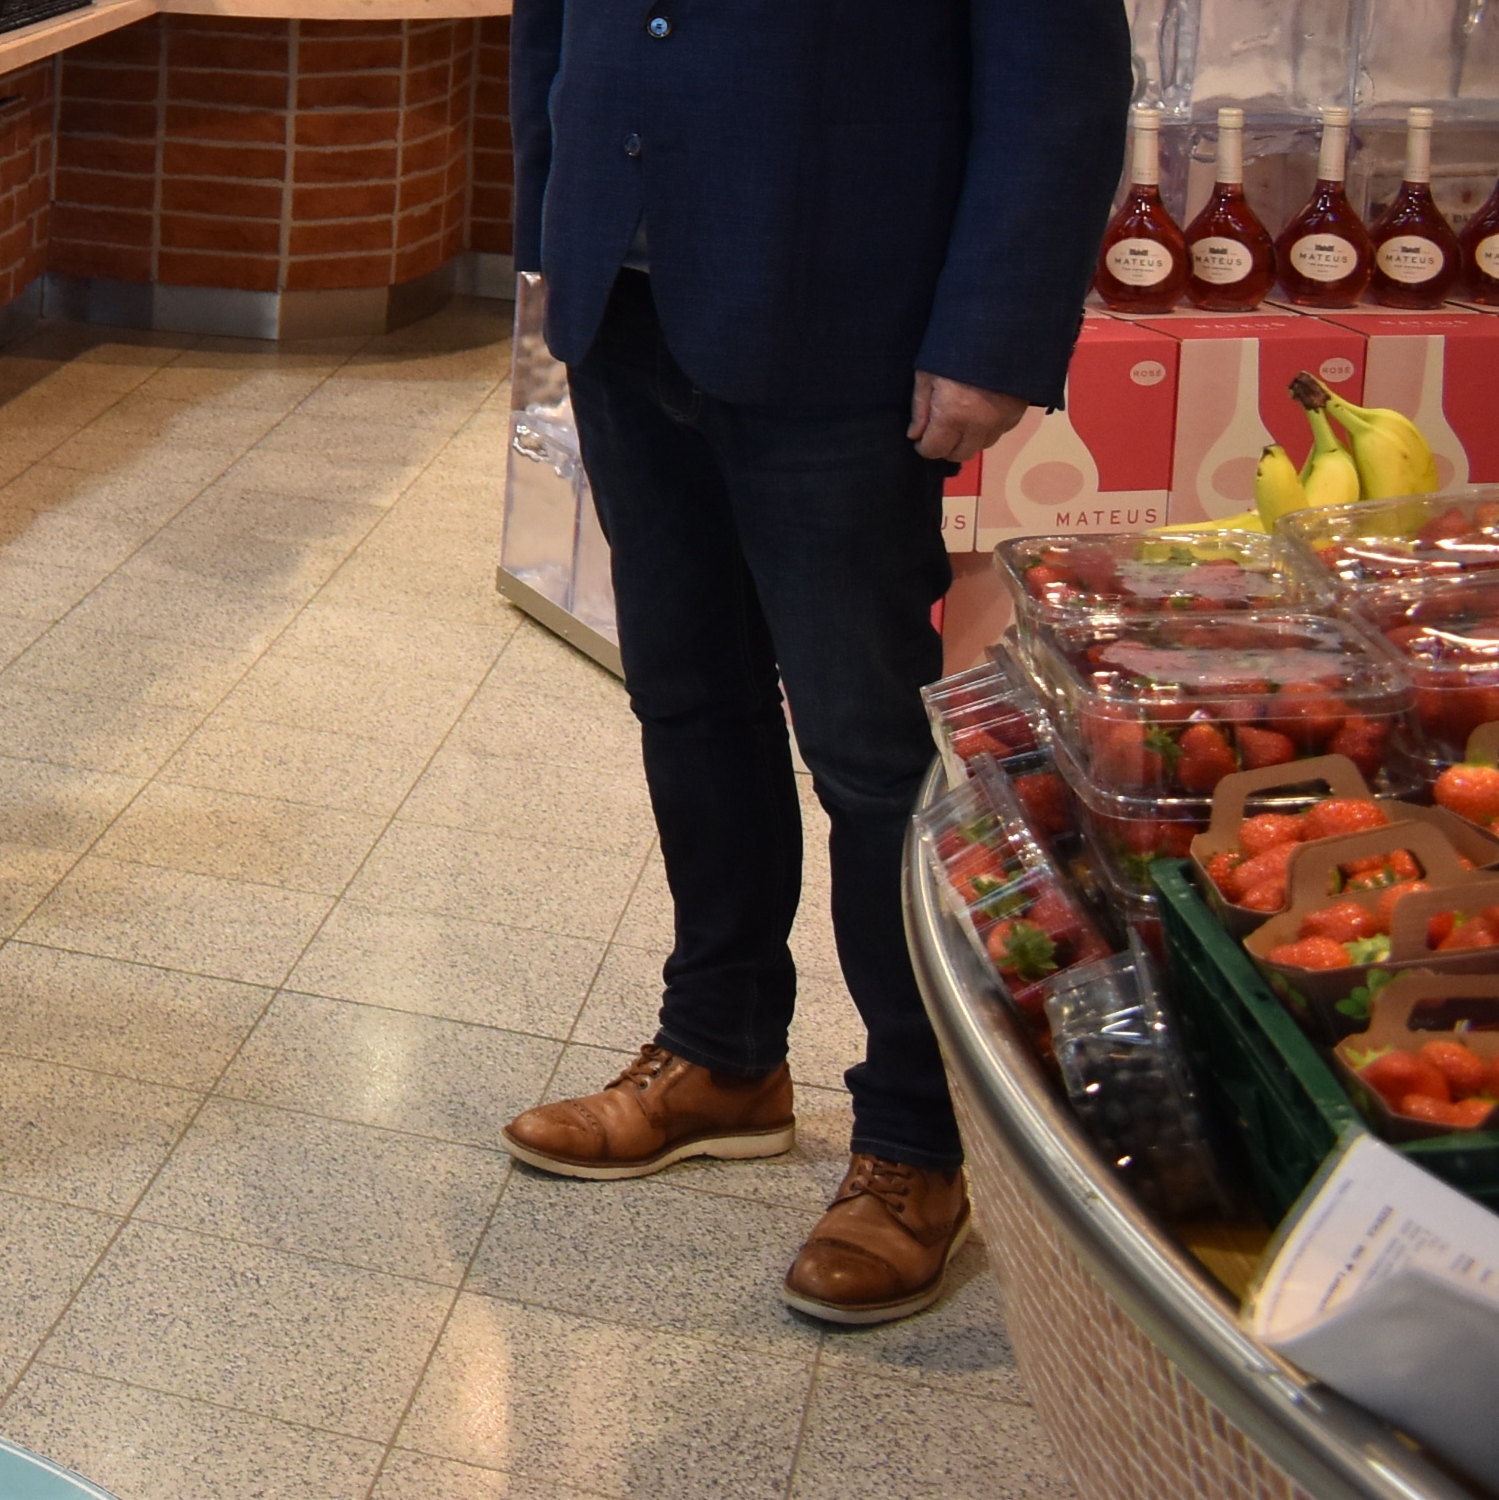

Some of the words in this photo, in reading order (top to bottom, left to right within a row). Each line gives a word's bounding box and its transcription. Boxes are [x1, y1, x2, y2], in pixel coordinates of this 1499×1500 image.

[1115, 258, 1163, 267] MATEUS
[1195, 255, 1243, 266] MATEUS
[1299, 252, 1348, 263] MATEUS
[1386, 254, 1434, 264] MATEUS
[1133, 368, 1163, 379] ROSÉ
[1056, 508, 1158, 527] MATEUS
